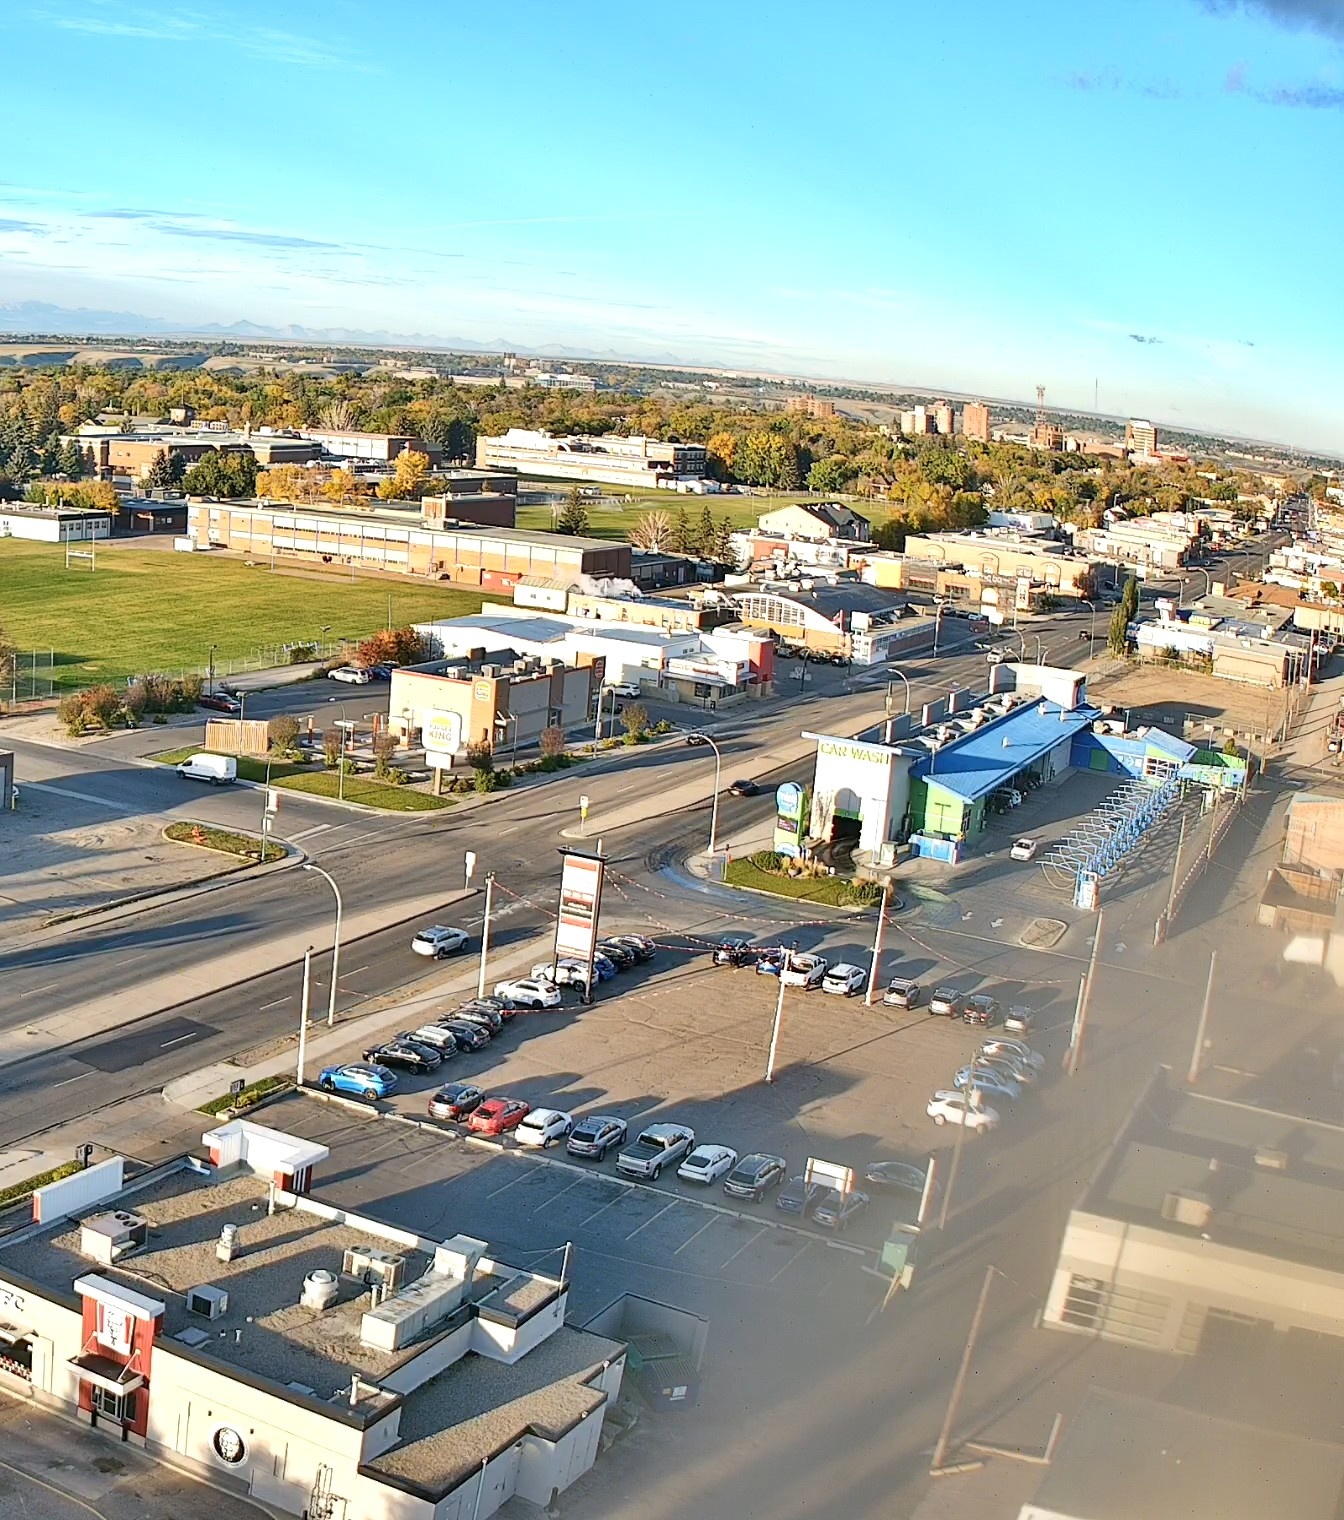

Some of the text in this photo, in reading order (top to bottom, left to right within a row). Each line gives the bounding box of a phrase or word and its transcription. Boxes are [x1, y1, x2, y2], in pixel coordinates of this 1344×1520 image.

[428, 731, 452, 742] KING
[821, 743, 890, 765] CAR WASH
